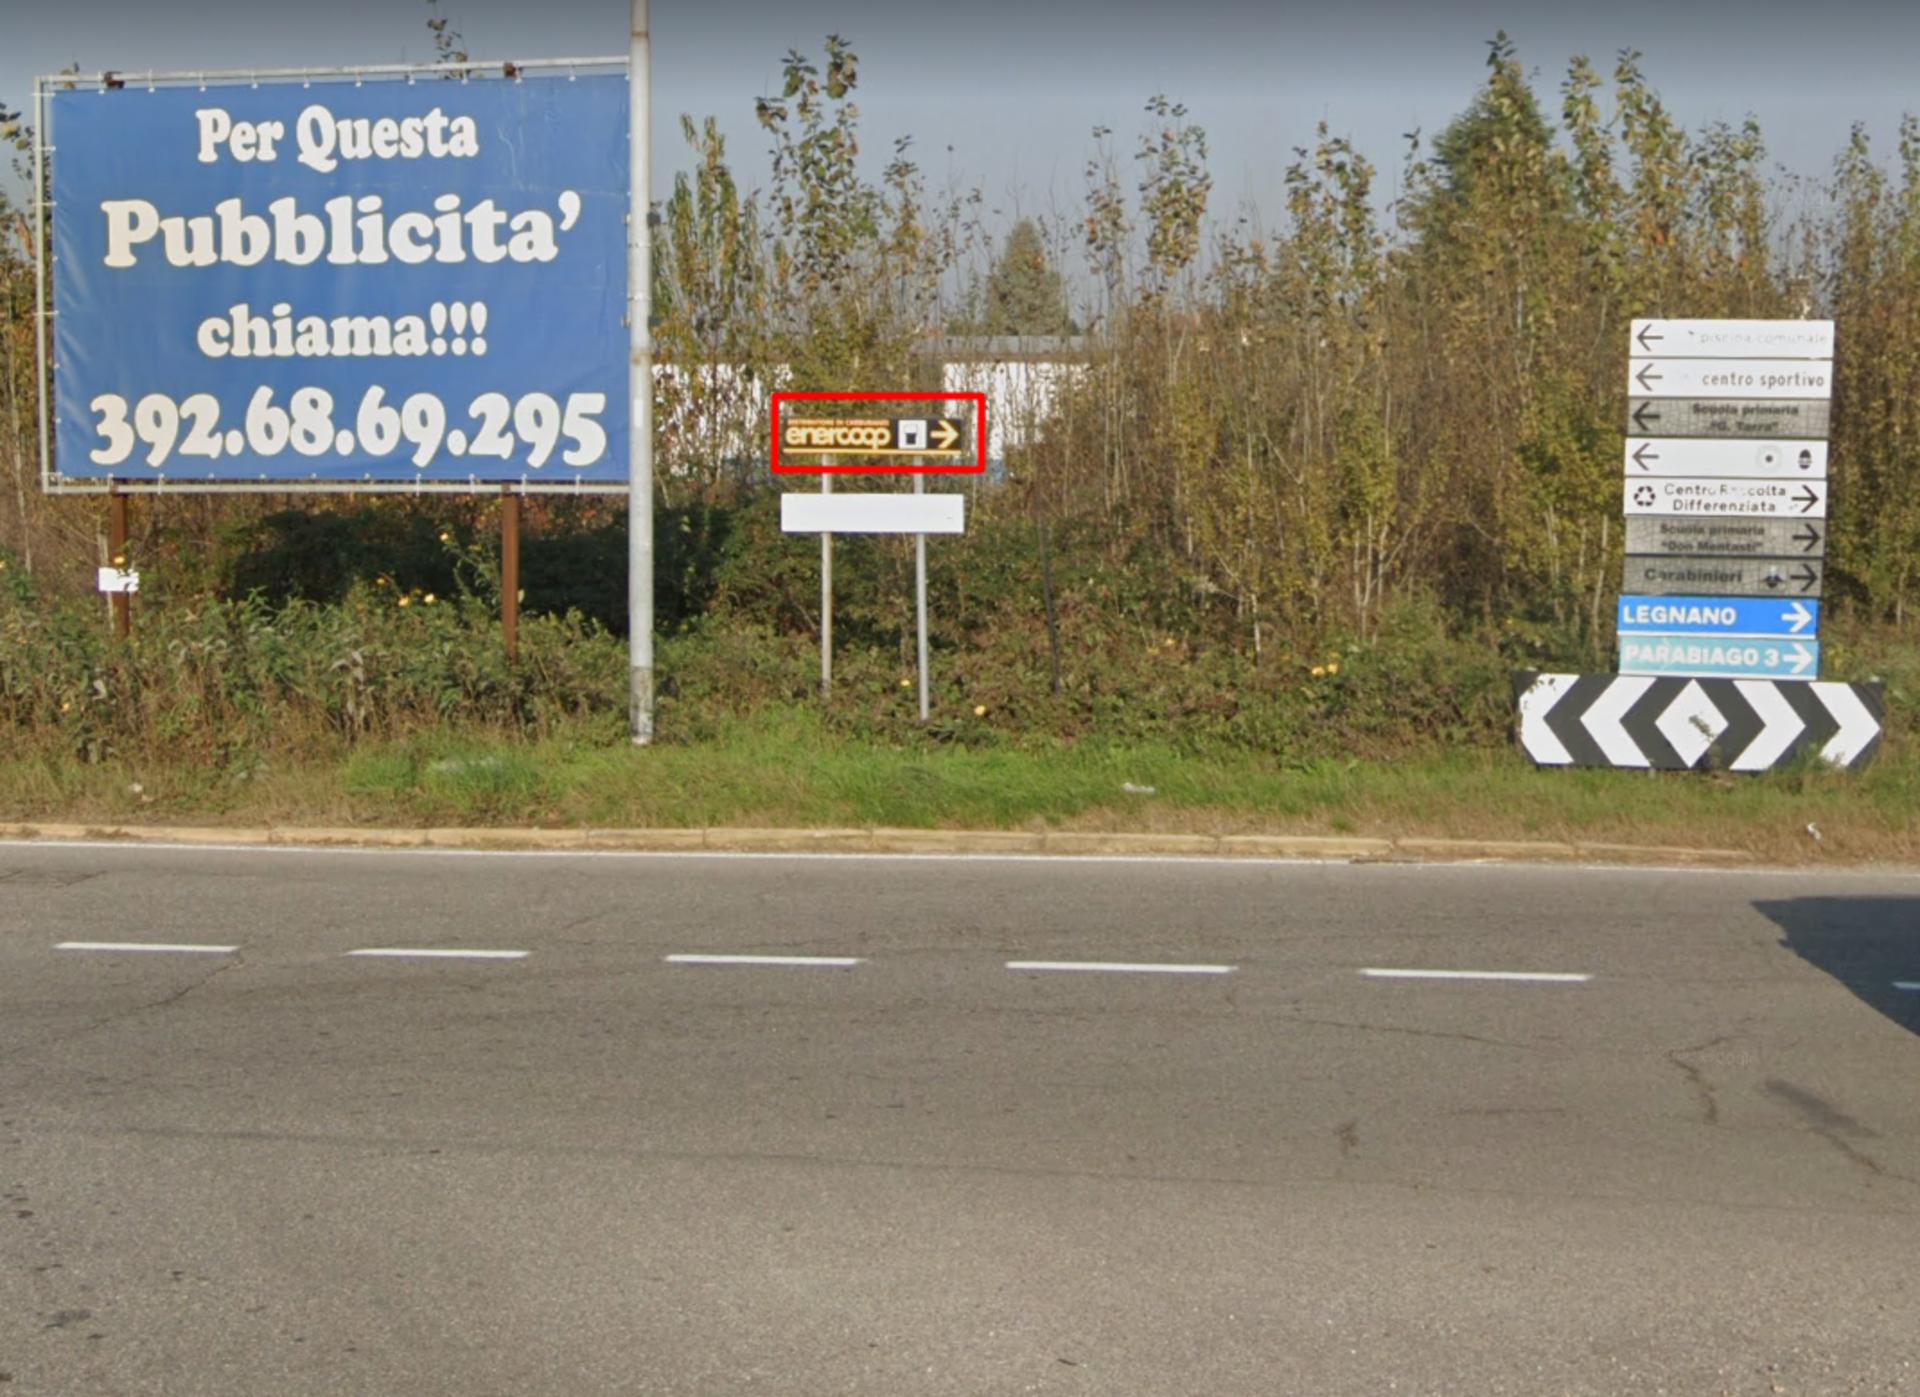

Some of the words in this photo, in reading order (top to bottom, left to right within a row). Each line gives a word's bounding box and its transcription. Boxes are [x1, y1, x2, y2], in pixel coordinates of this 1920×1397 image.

[195, 108, 284, 164] Per
[296, 104, 479, 173] Questa
[101, 190, 582, 269] Pubblicita'
[197, 301, 488, 358] chiama!!!
[1702, 371, 1754, 387] centro
[1760, 371, 1825, 389] sportivo
[1742, 404, 1799, 417] primaria
[89, 385, 606, 468] 392.68.69.295
[785, 426, 891, 450] enercoop
[1719, 484, 1786, 497] Rcolta
[1672, 499, 1776, 512] Differenziata
[1644, 567, 1743, 583] Carabinieri
[1623, 605, 1738, 625] LEGNANO
[1625, 645, 1759, 667] PARABIAGO
[1764, 650, 1780, 667] 3
